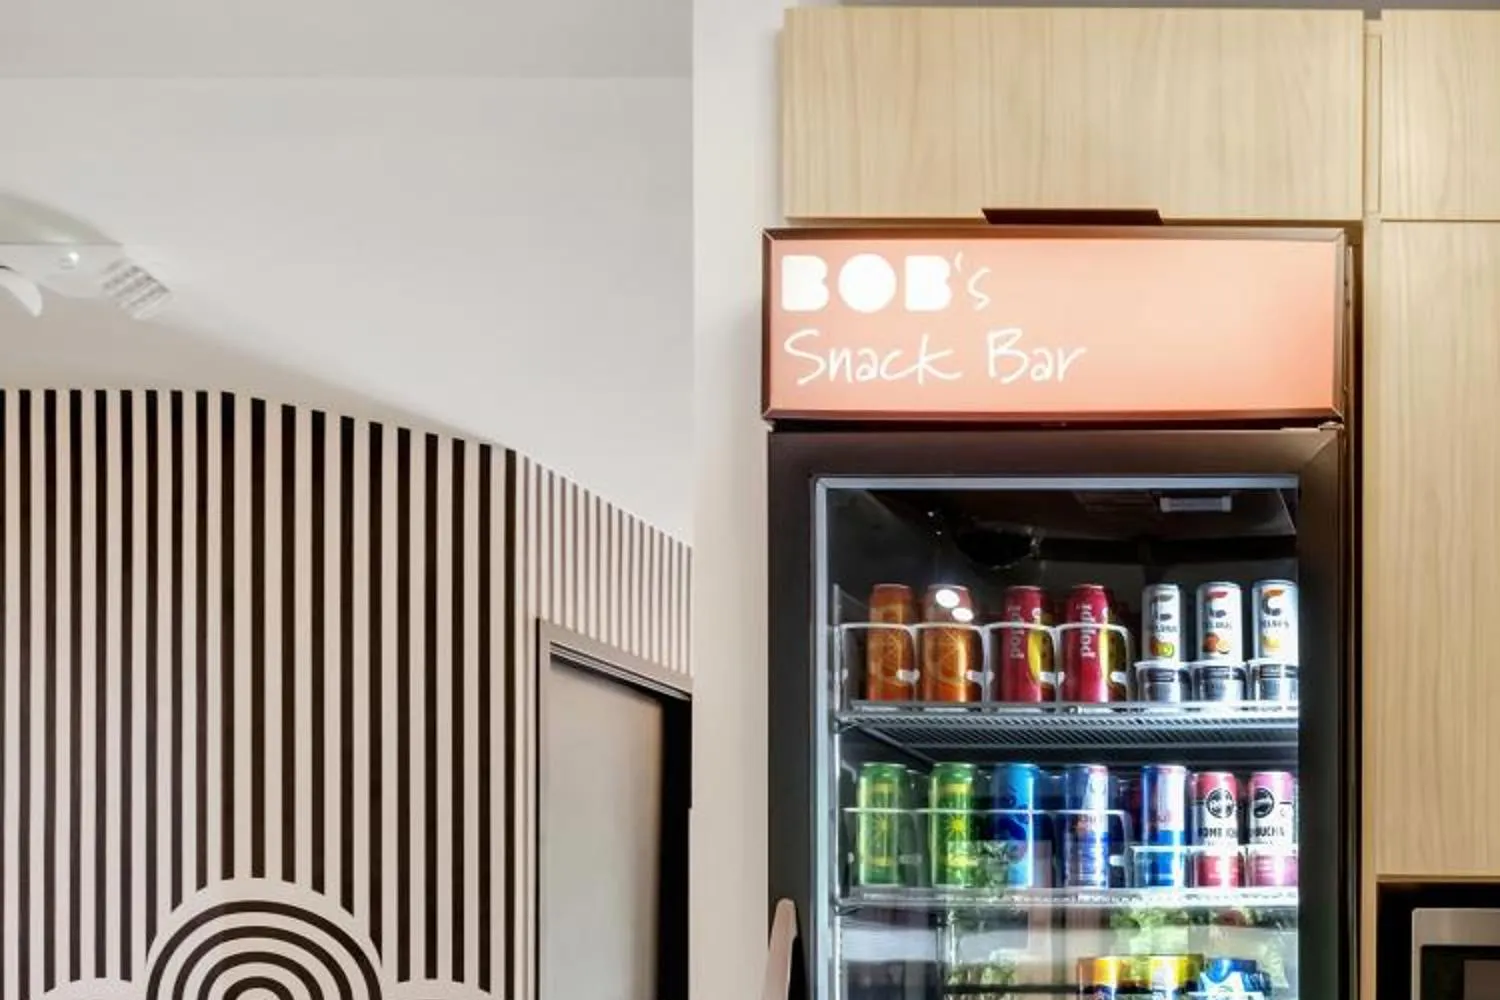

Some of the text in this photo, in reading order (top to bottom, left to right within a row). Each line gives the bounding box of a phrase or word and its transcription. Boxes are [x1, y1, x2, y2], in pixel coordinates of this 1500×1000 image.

[781, 251, 992, 313] BOB's
[783, 328, 1087, 386] Snack Bar
[1076, 602, 1097, 658] poppi
